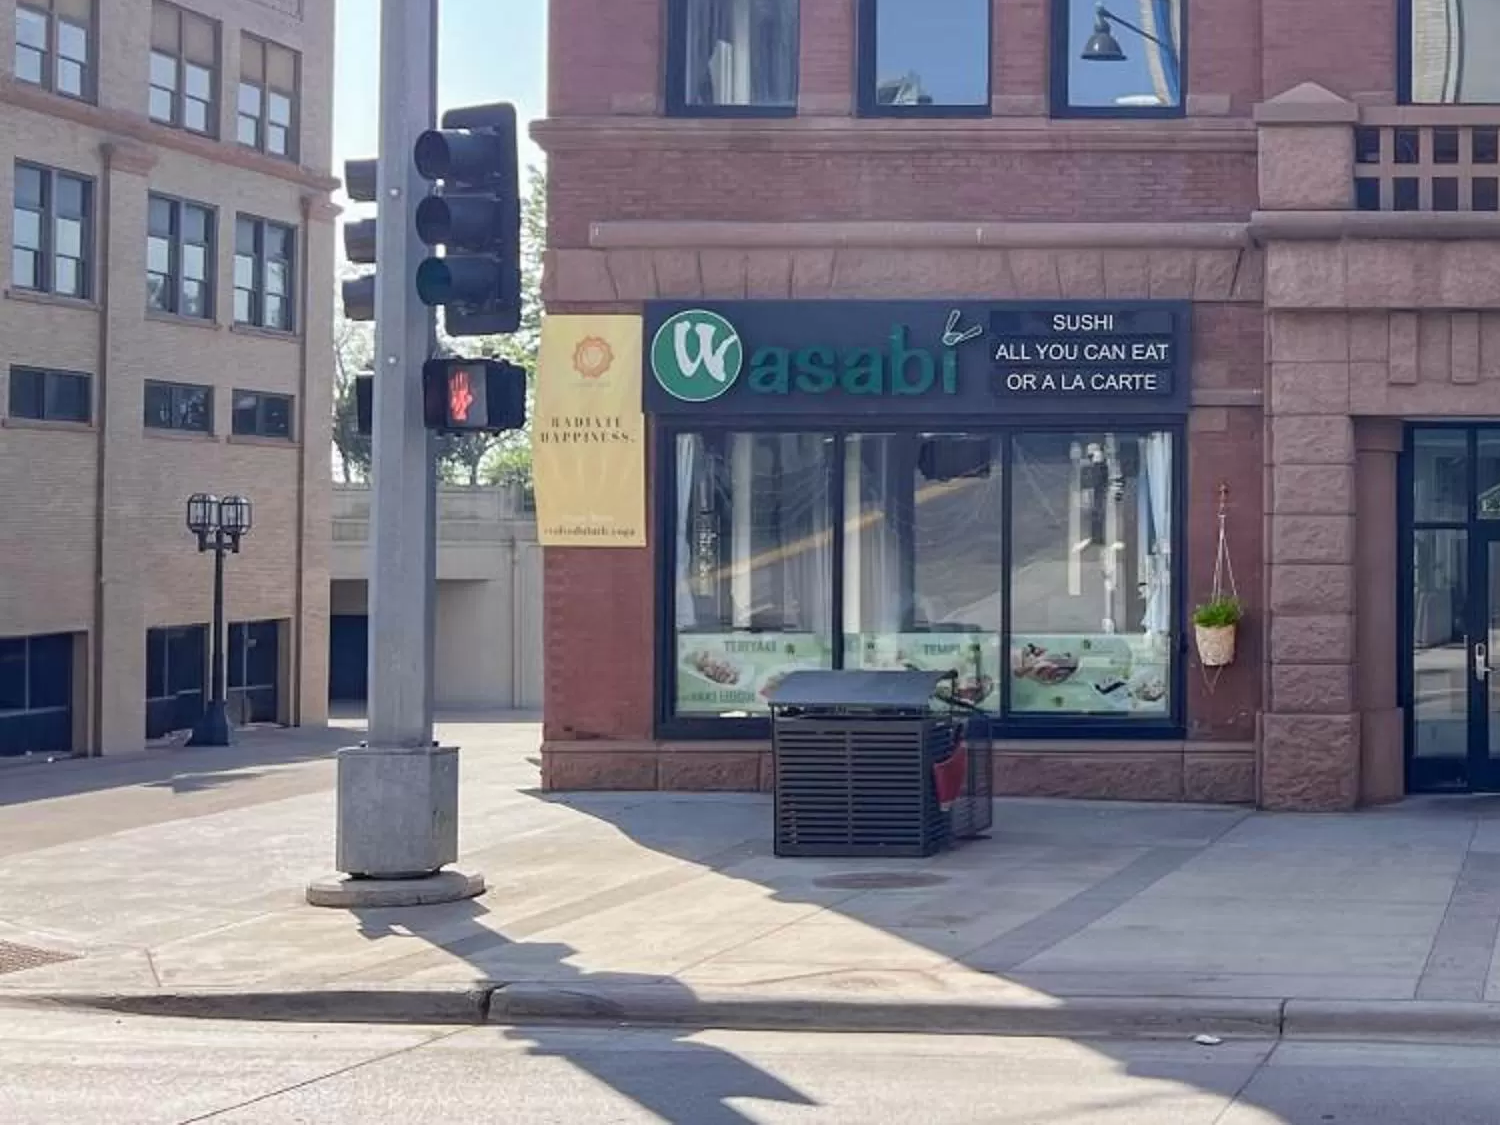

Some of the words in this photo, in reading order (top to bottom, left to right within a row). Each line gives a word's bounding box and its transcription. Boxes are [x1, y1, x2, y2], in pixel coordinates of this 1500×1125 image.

[1053, 314, 1113, 331] SUSHI
[995, 344, 1032, 360] ALL
[1035, 344, 1079, 360] YOU
[1083, 344, 1126, 360] CAN
[1131, 344, 1169, 360] EAT
[1006, 374, 1037, 390] OR
[1041, 374, 1056, 390] A
[1061, 374, 1085, 390] LA
[1091, 374, 1157, 390] CARTE
